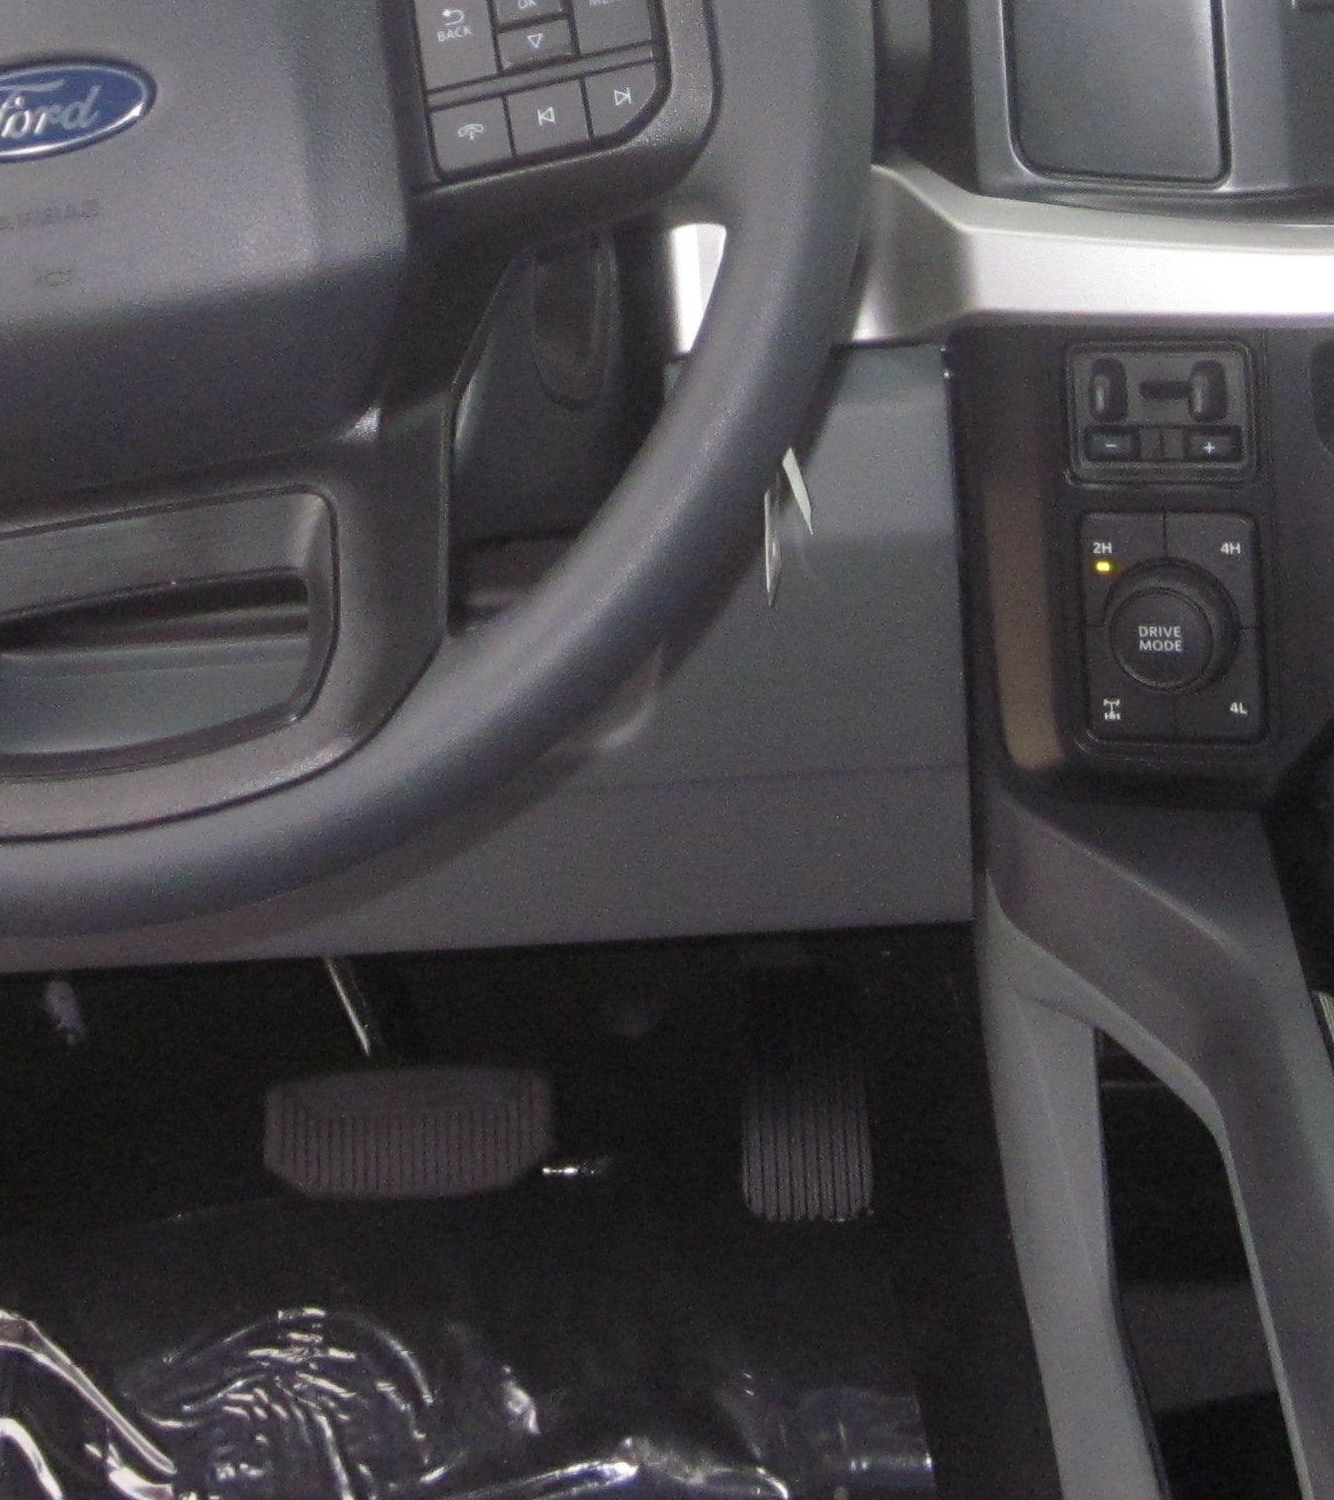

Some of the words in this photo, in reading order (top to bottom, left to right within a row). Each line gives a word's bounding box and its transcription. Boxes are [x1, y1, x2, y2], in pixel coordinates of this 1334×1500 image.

[437, 24, 474, 42] BACK
[1092, 542, 1113, 554] 2H
[1220, 542, 1242, 555] 4H
[1138, 625, 1182, 638] DRIVE
[1138, 639, 1183, 652] MODE
[1229, 702, 1248, 715] 4L
